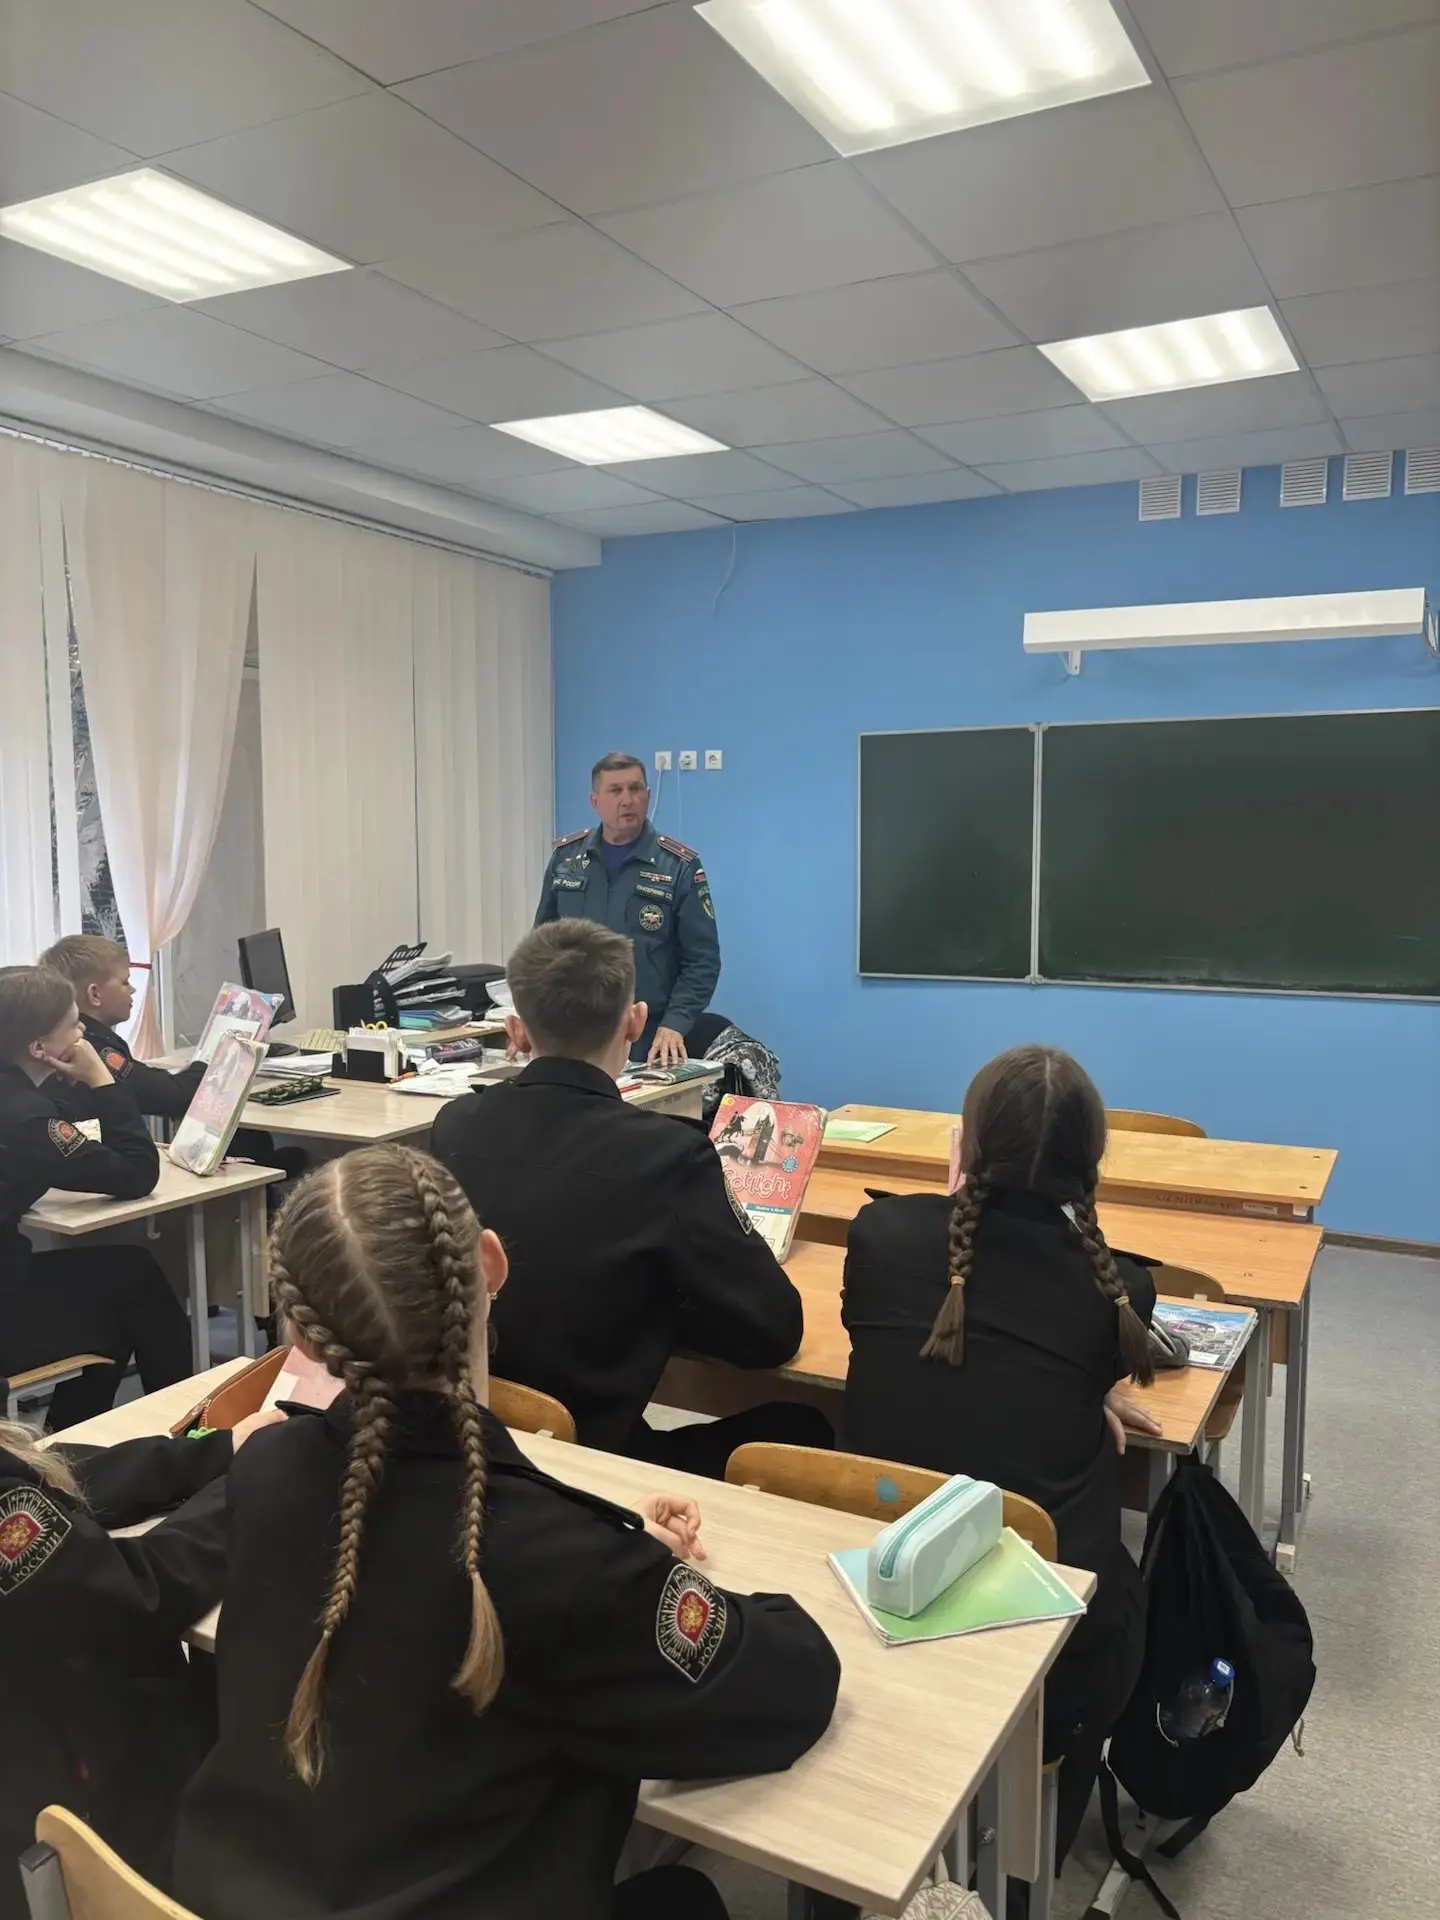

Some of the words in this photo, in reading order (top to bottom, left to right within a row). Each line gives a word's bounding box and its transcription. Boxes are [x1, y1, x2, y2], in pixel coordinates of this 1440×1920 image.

[722, 1160, 791, 1200] potlight
[11, 1531, 61, 1583] РОССИИ
[697, 1606, 725, 1668] РОССИИ
